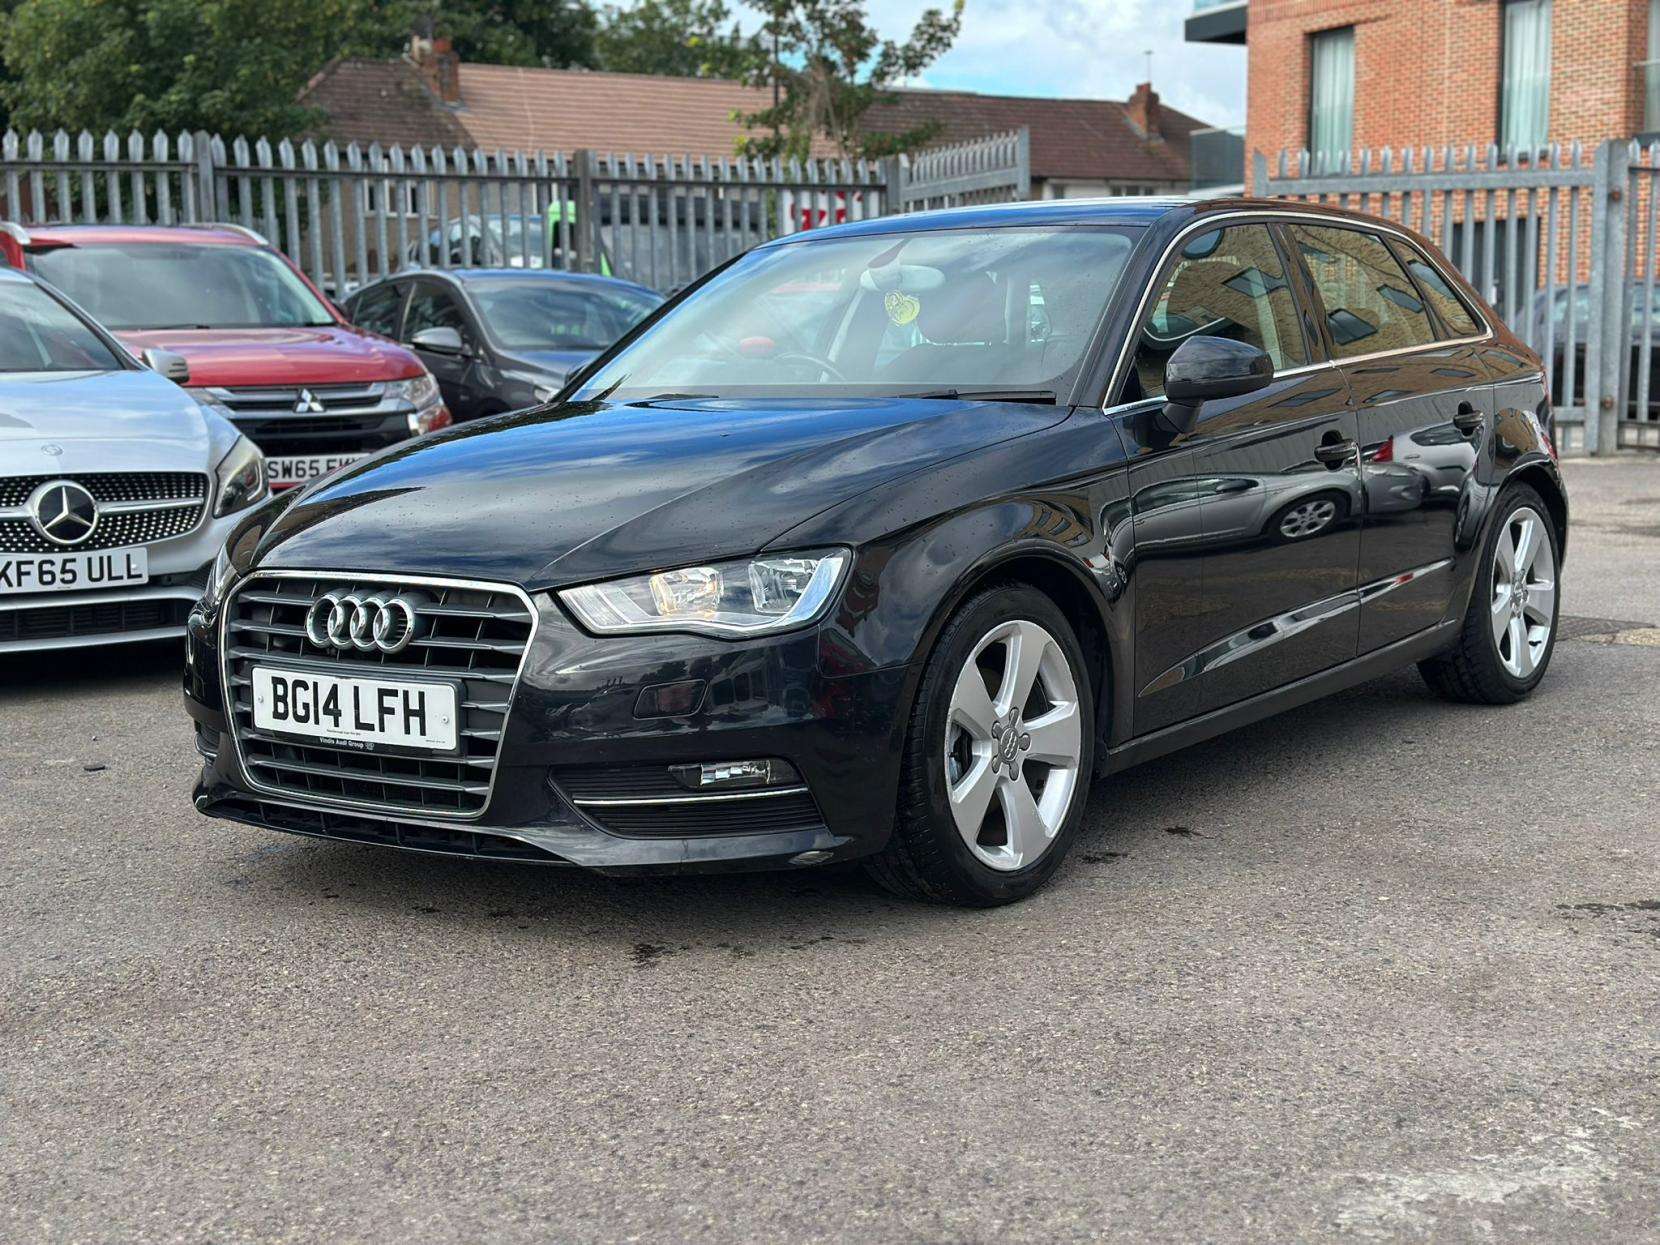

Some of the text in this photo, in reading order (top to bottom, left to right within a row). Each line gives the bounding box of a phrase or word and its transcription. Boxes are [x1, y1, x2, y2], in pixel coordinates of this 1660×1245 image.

[267, 457, 320, 479] SW65
[0, 553, 143, 588] KF65 ULL
[271, 676, 427, 737] BG14 LFH
